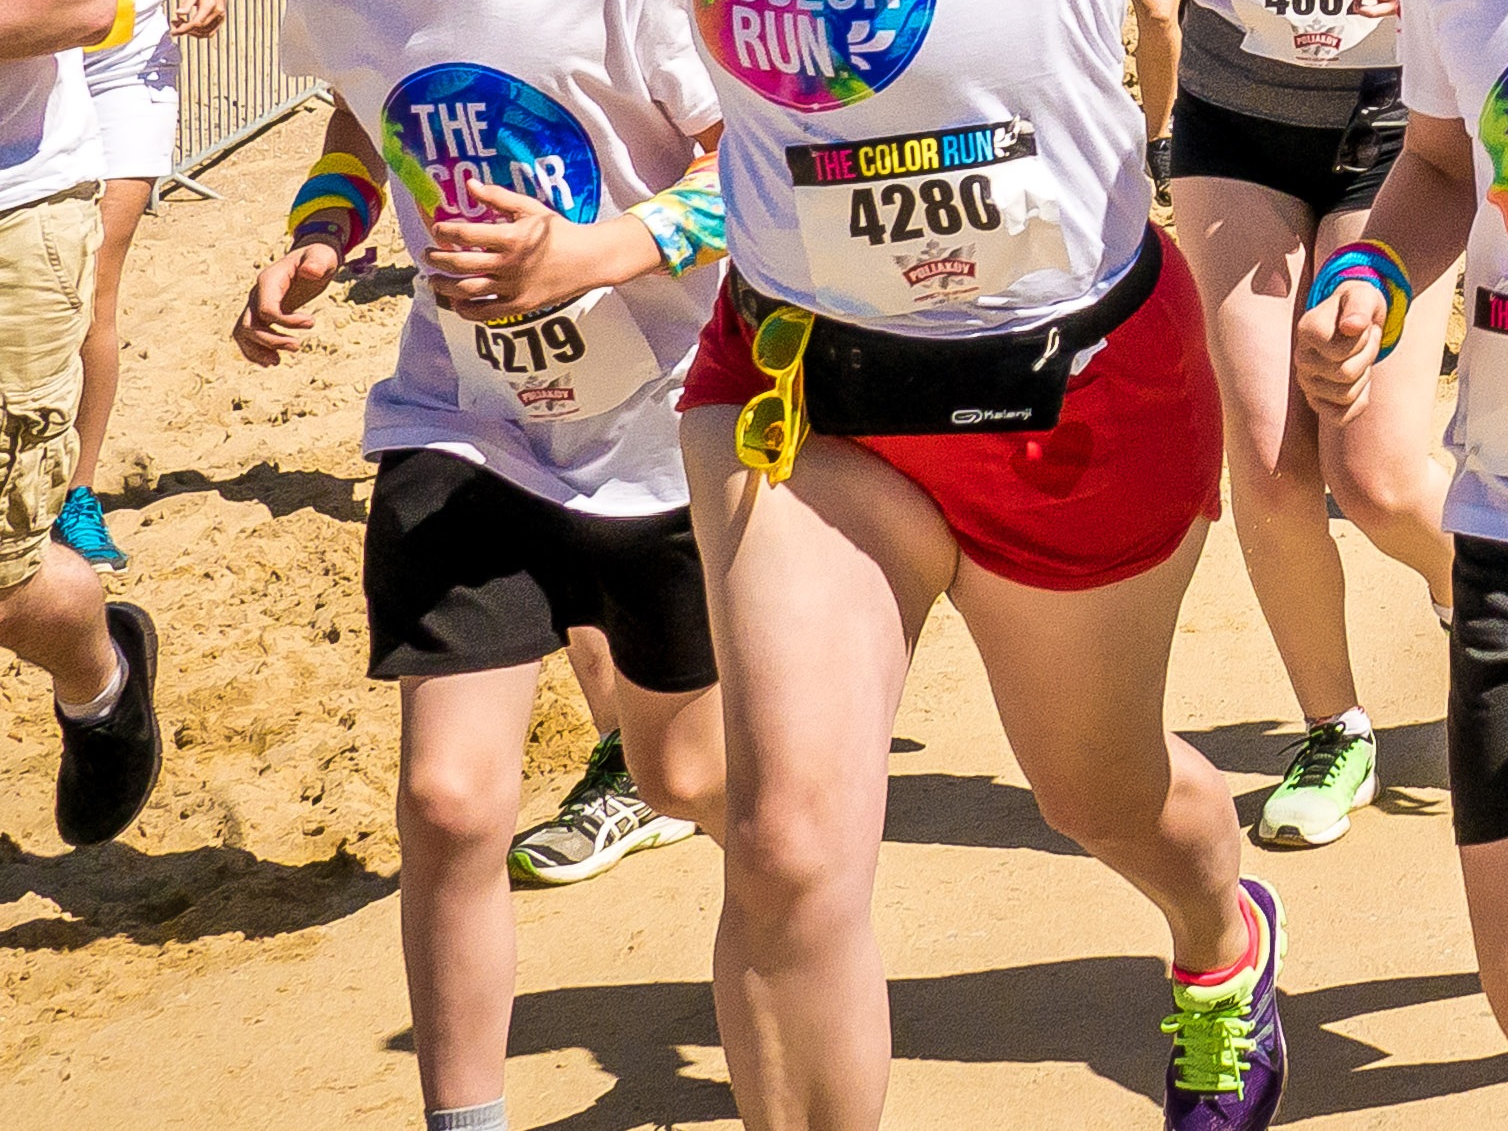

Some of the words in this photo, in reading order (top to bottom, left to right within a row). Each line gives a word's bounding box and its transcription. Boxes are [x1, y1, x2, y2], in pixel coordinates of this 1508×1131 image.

[732, 4, 835, 79] RUN
[410, 101, 498, 162] THE
[812, 148, 858, 182] THE
[858, 137, 940, 178] COLOR
[942, 129, 996, 168] RUN
[849, 173, 1002, 246] 4280
[474, 315, 587, 374] 4279
